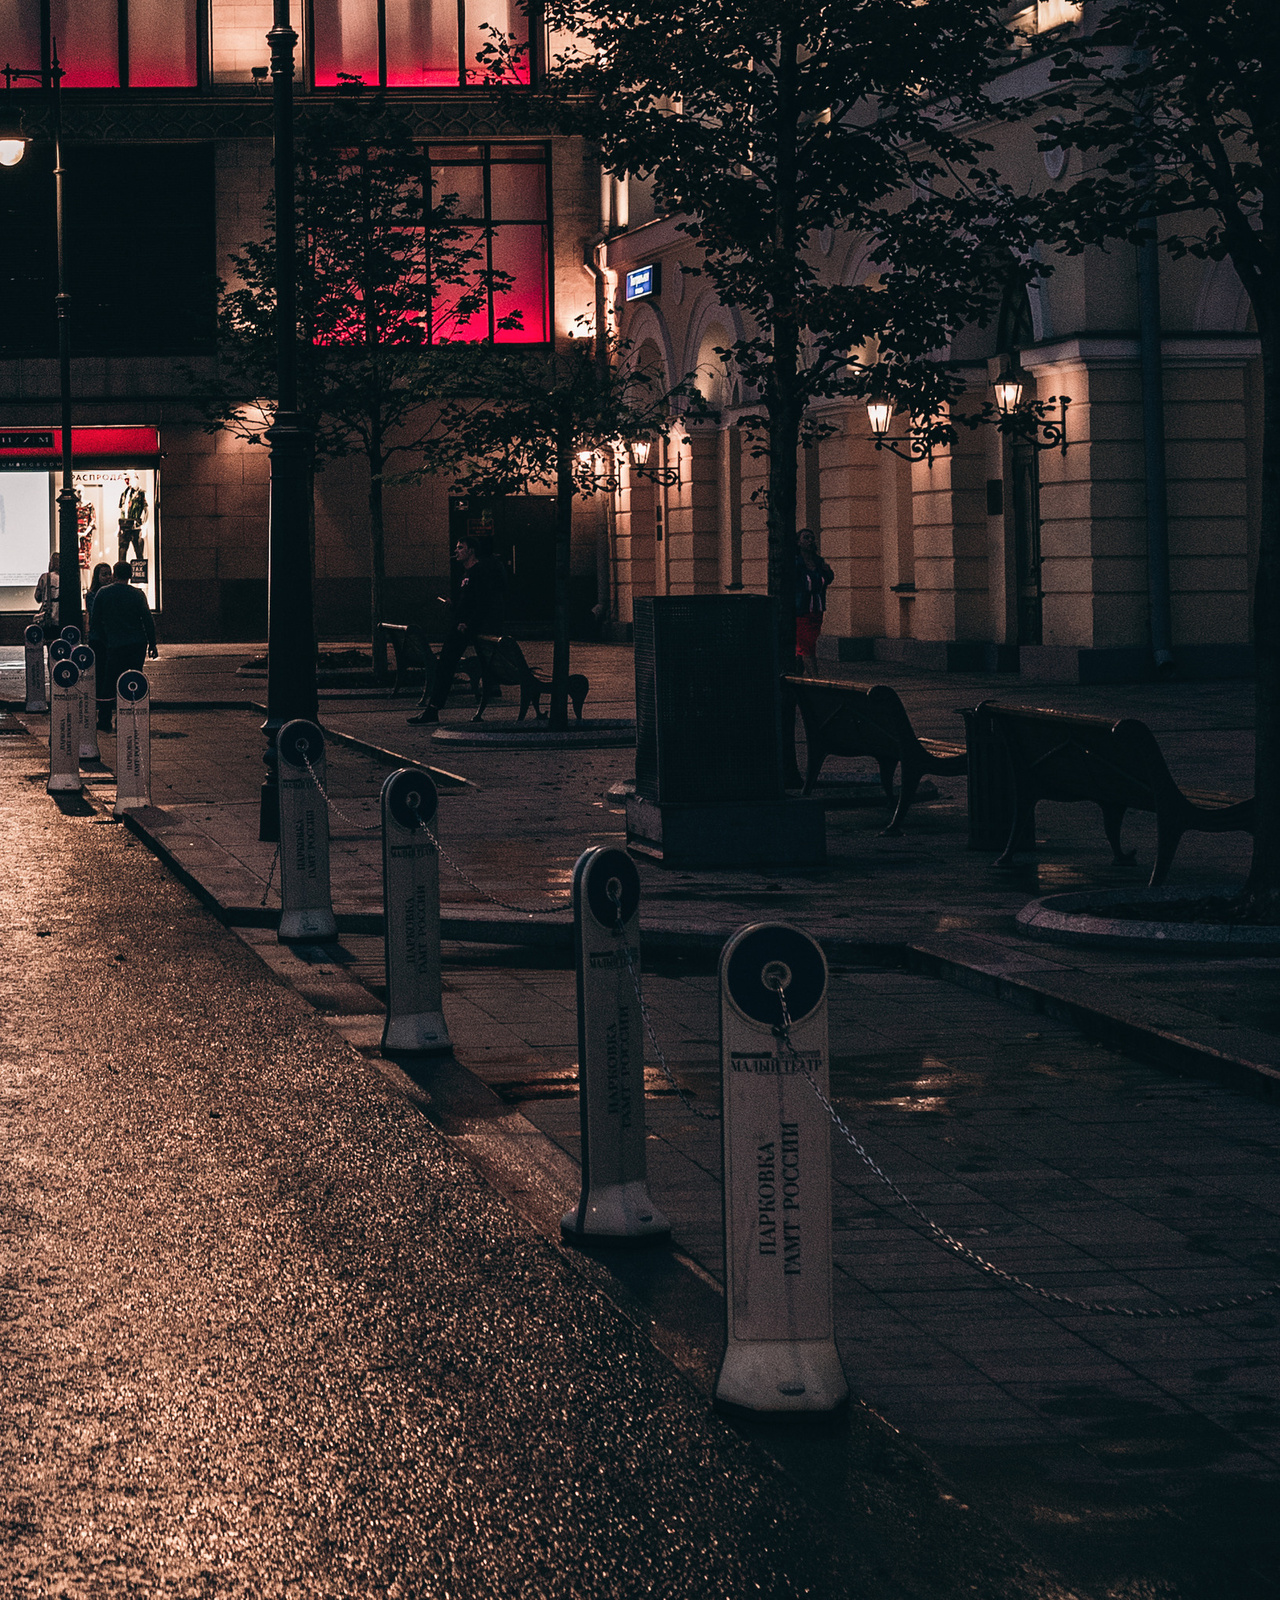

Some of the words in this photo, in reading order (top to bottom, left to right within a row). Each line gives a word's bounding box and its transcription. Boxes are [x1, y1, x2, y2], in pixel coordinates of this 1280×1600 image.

[405, 897, 415, 964] ПАРКОВКА
[607, 1022, 618, 1115] ПАРКОВКА
[758, 1142, 777, 1257] ПАРКОВКА
[781, 1122, 800, 1211] РОССИИ
[783, 1221, 802, 1276] ГАМТ
